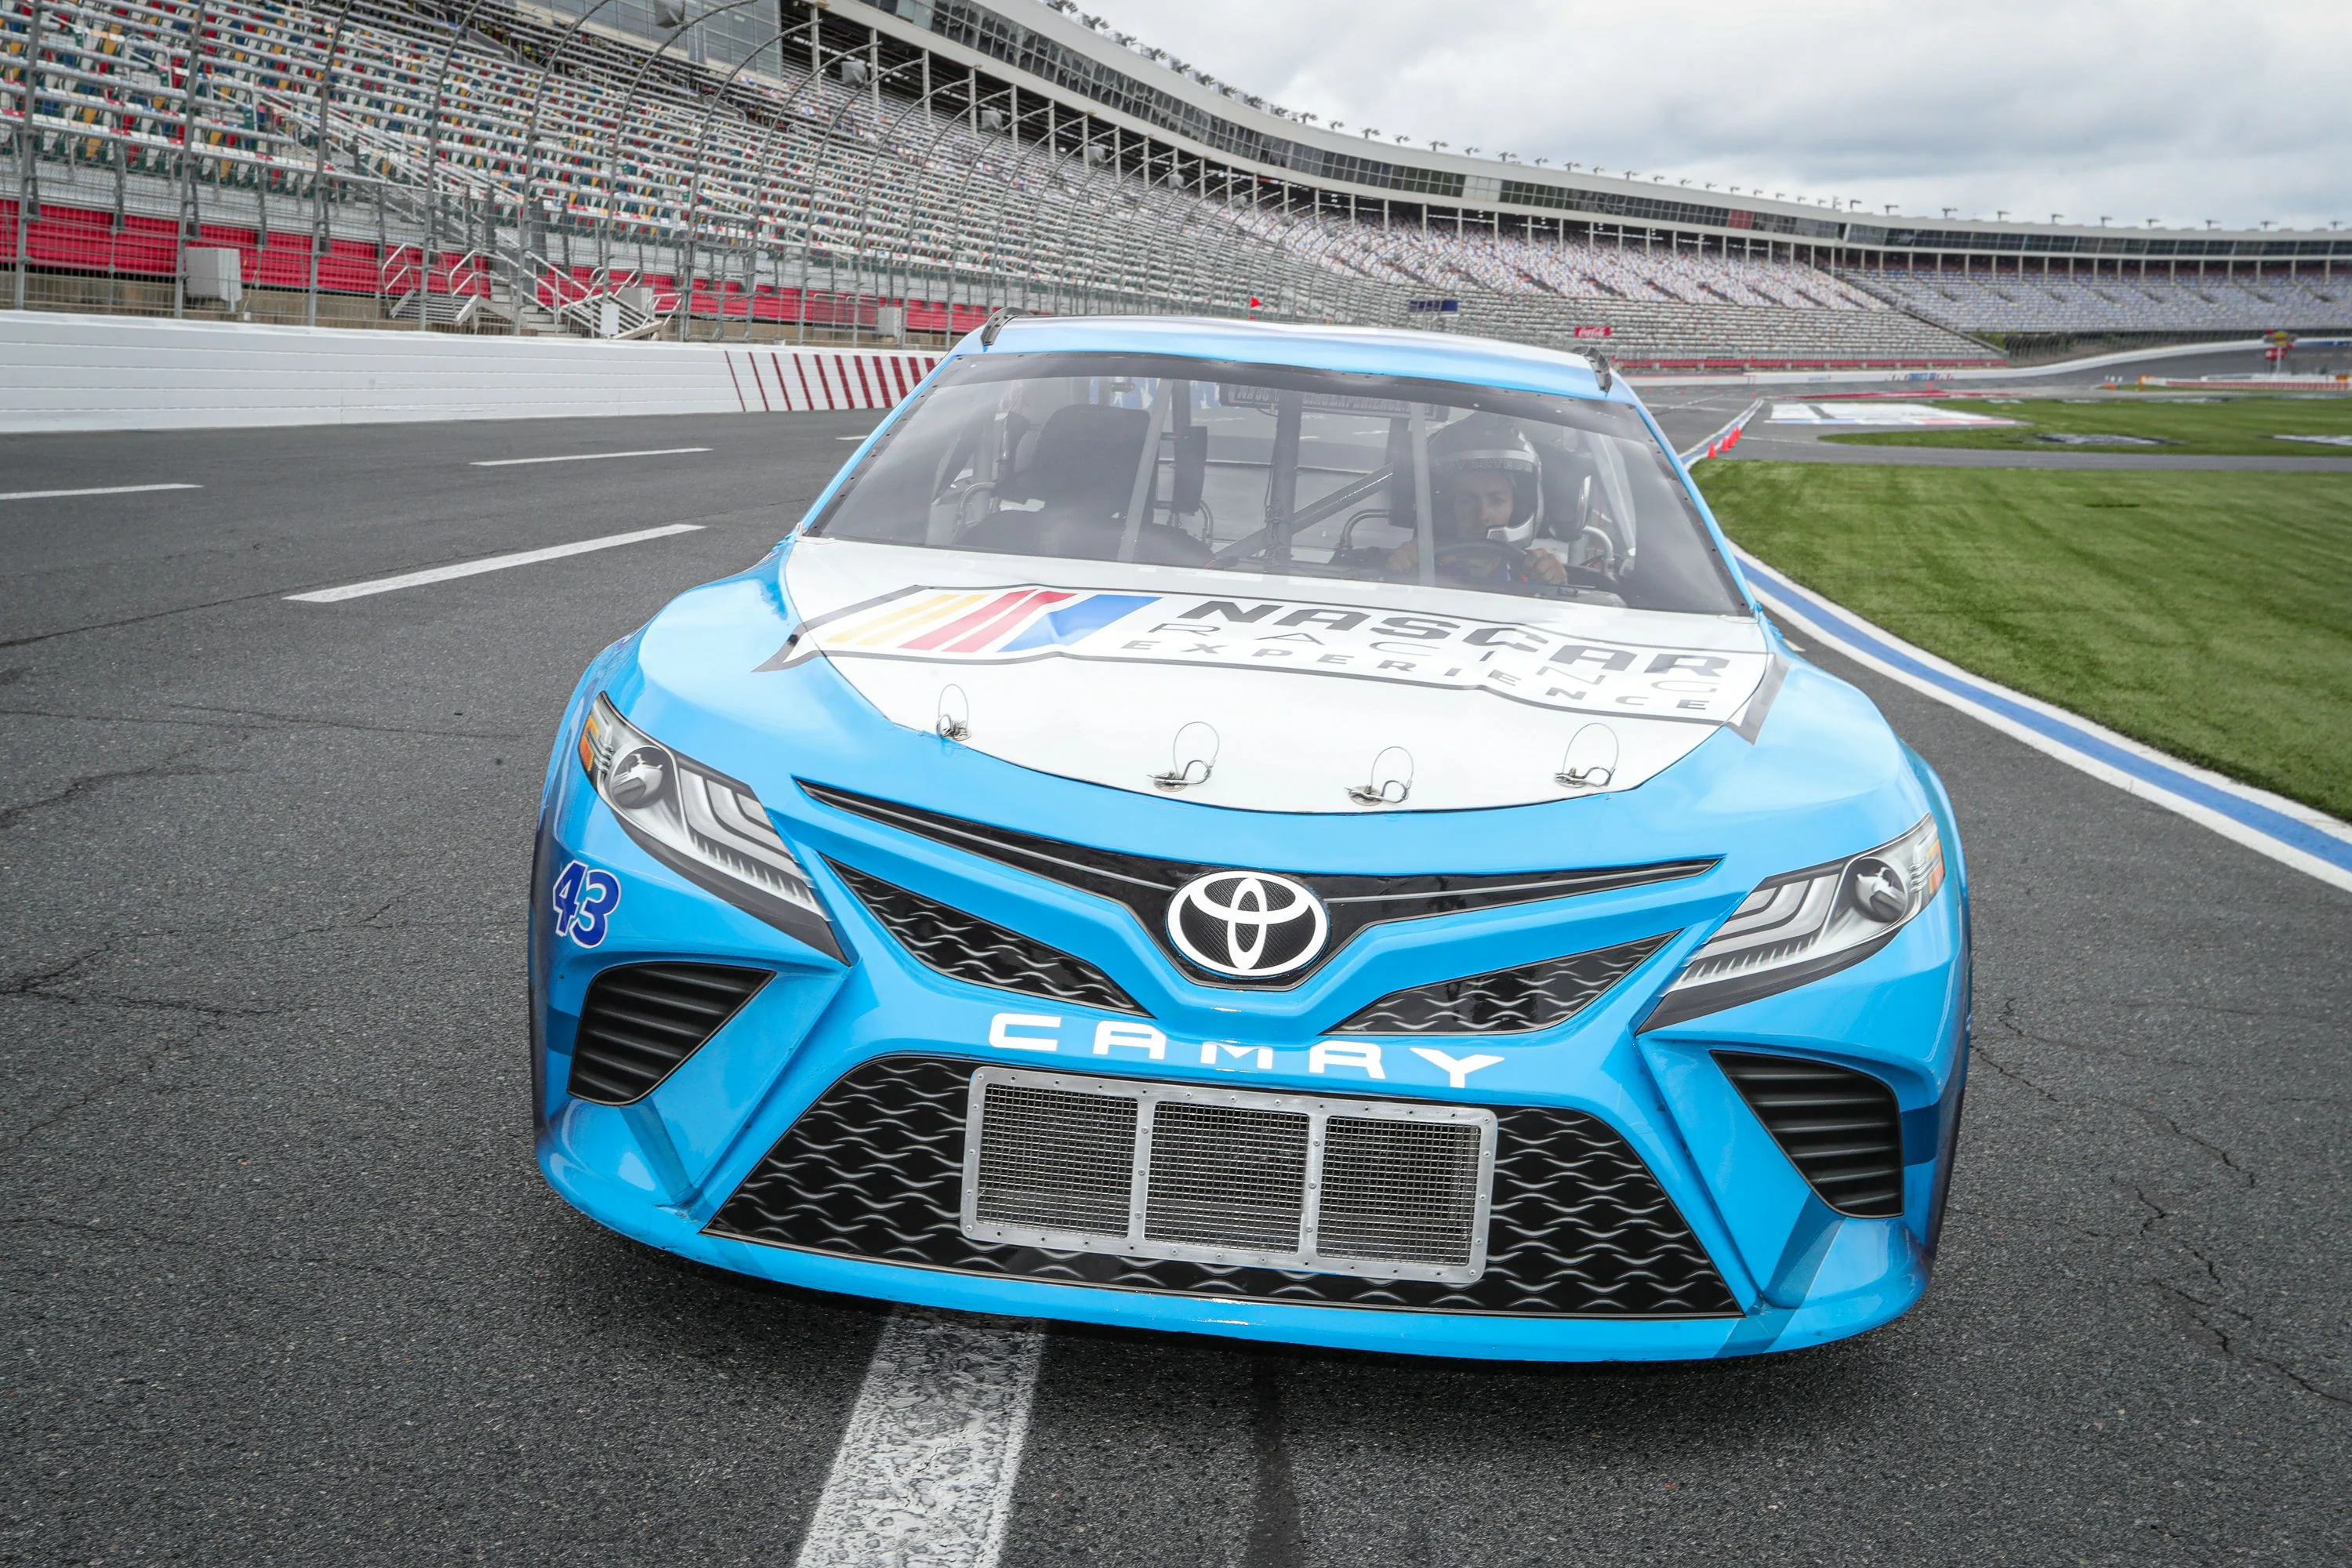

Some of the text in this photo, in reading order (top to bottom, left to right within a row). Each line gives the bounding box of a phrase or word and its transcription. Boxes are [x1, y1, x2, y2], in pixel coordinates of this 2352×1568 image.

[1120, 639, 1711, 710] EXPERIENCE
[1147, 622, 1720, 693] RACING
[1176, 600, 1731, 677] NASCAR
[552, 859, 622, 949] 43
[989, 1012, 1505, 1088] CAMRY
